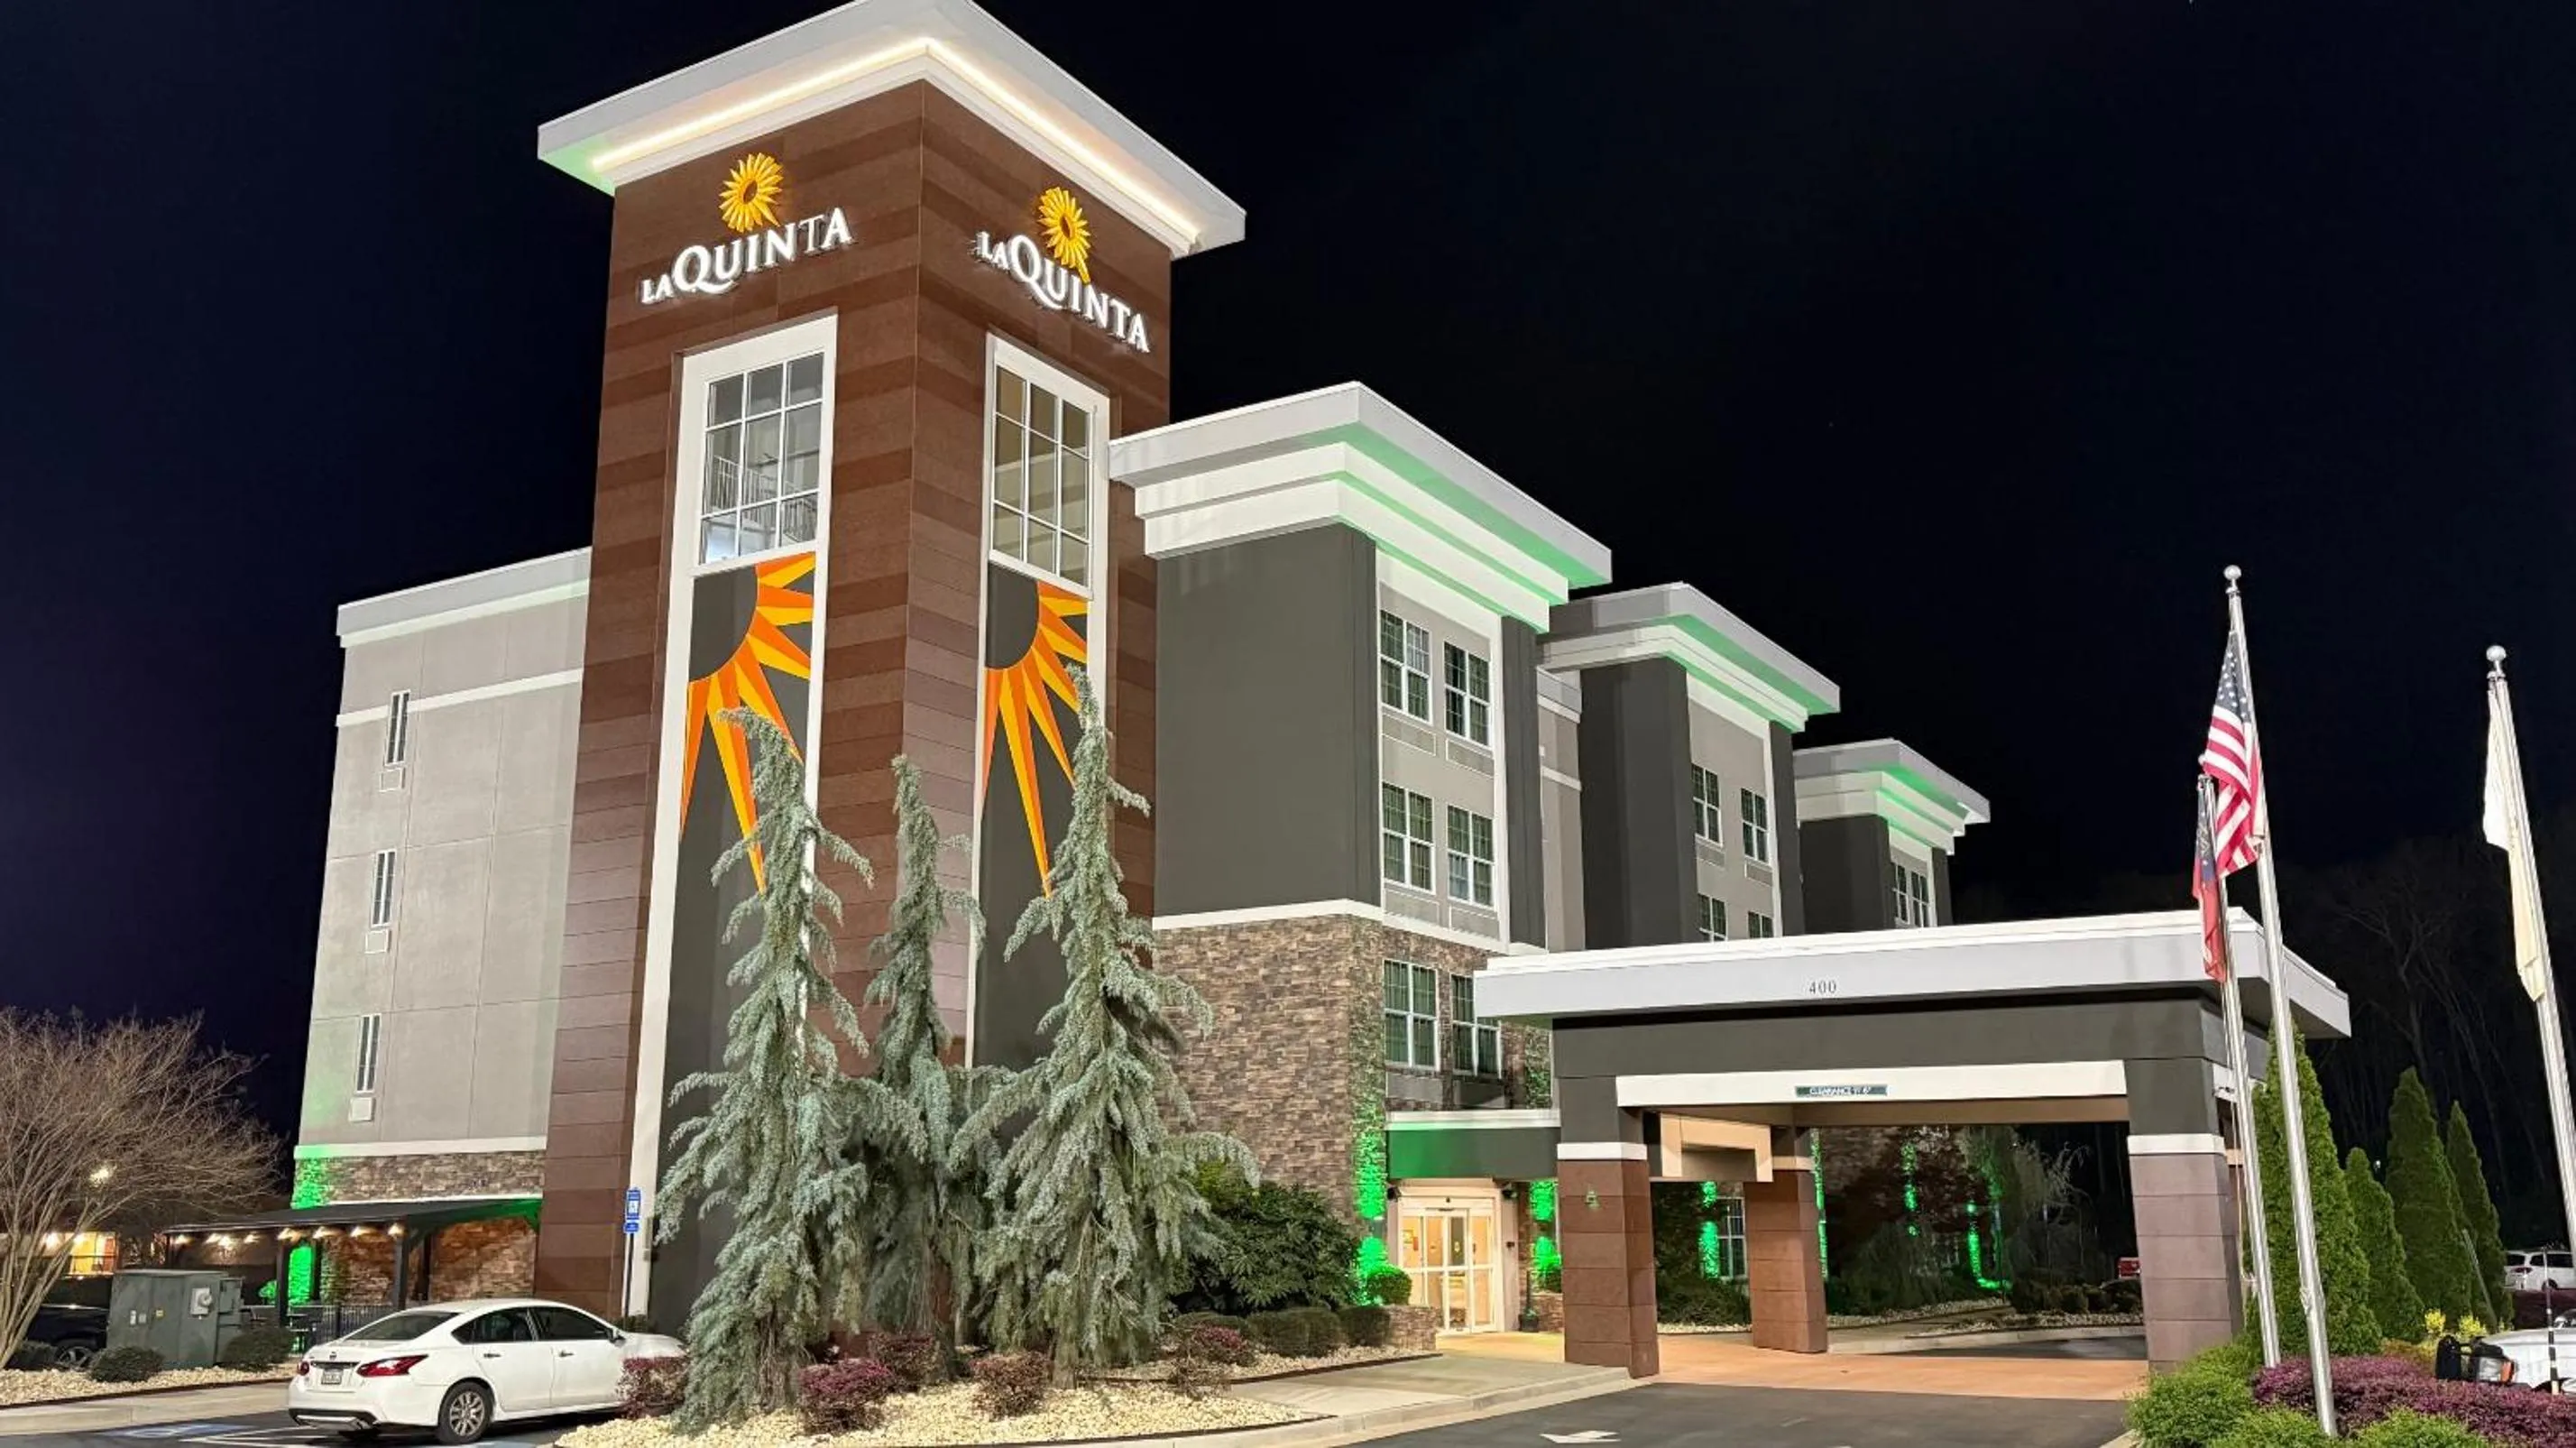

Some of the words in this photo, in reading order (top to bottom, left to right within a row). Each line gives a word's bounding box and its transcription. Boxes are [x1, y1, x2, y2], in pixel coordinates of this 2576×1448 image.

[640, 273, 675, 304] LA
[670, 208, 854, 294] QUINTA
[975, 231, 1011, 271] LA
[1007, 235, 1150, 353] QUINTA
[1809, 980, 1837, 994] 400
